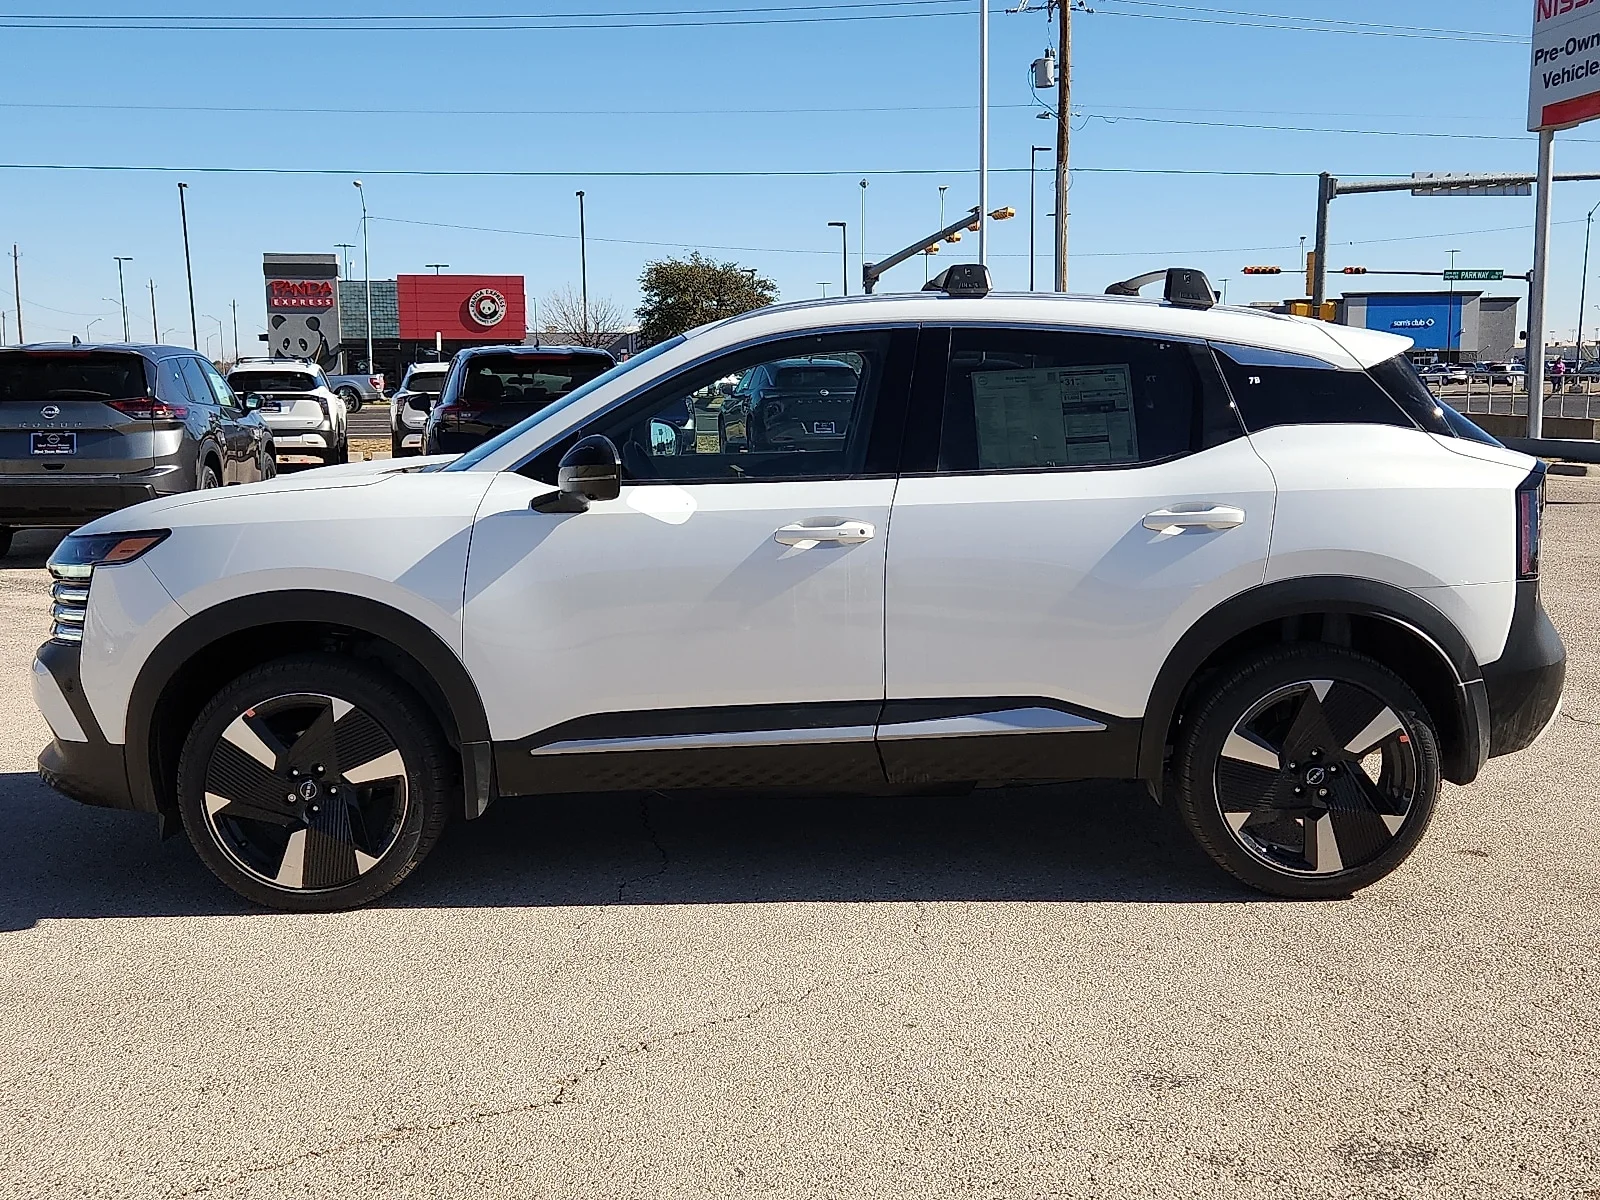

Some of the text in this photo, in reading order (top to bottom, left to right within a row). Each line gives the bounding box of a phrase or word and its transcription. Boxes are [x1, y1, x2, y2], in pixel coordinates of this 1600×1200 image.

[1543, 60, 1600, 89] Vehicle
[1461, 271, 1489, 279] PARKWAY
[271, 279, 333, 296] PANDA
[470, 290, 506, 308] PANDA EXPRESS
